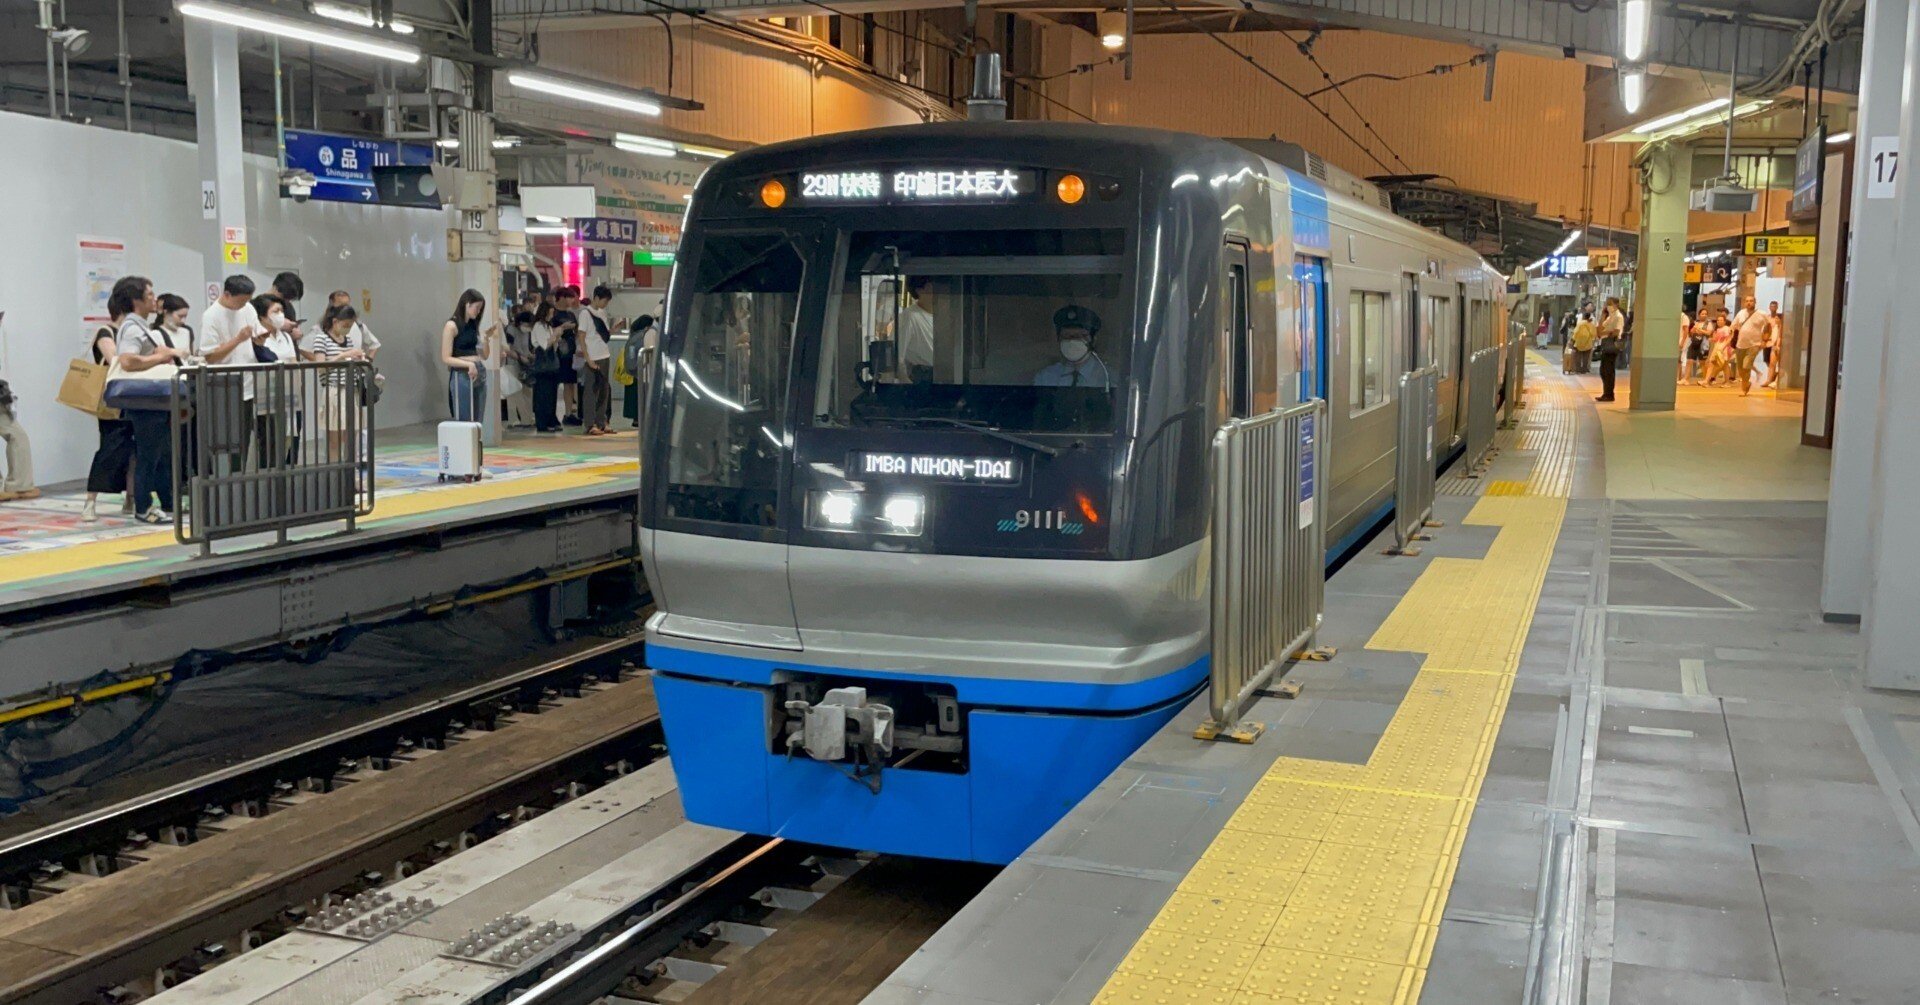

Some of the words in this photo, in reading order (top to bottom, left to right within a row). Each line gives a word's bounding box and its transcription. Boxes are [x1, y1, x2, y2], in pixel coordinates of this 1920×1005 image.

[352, 140, 379, 150] しながわ
[325, 167, 364, 179] Shinagawa
[1874, 152, 1898, 183] 17
[204, 190, 215, 210] 20
[470, 211, 482, 229] 19
[595, 220, 633, 240] 乗車口
[1548, 258, 1560, 272] 2
[865, 454, 906, 474] IMBA
[911, 456, 1012, 479] NIHON-IDAI
[1015, 509, 1063, 530] 9111
